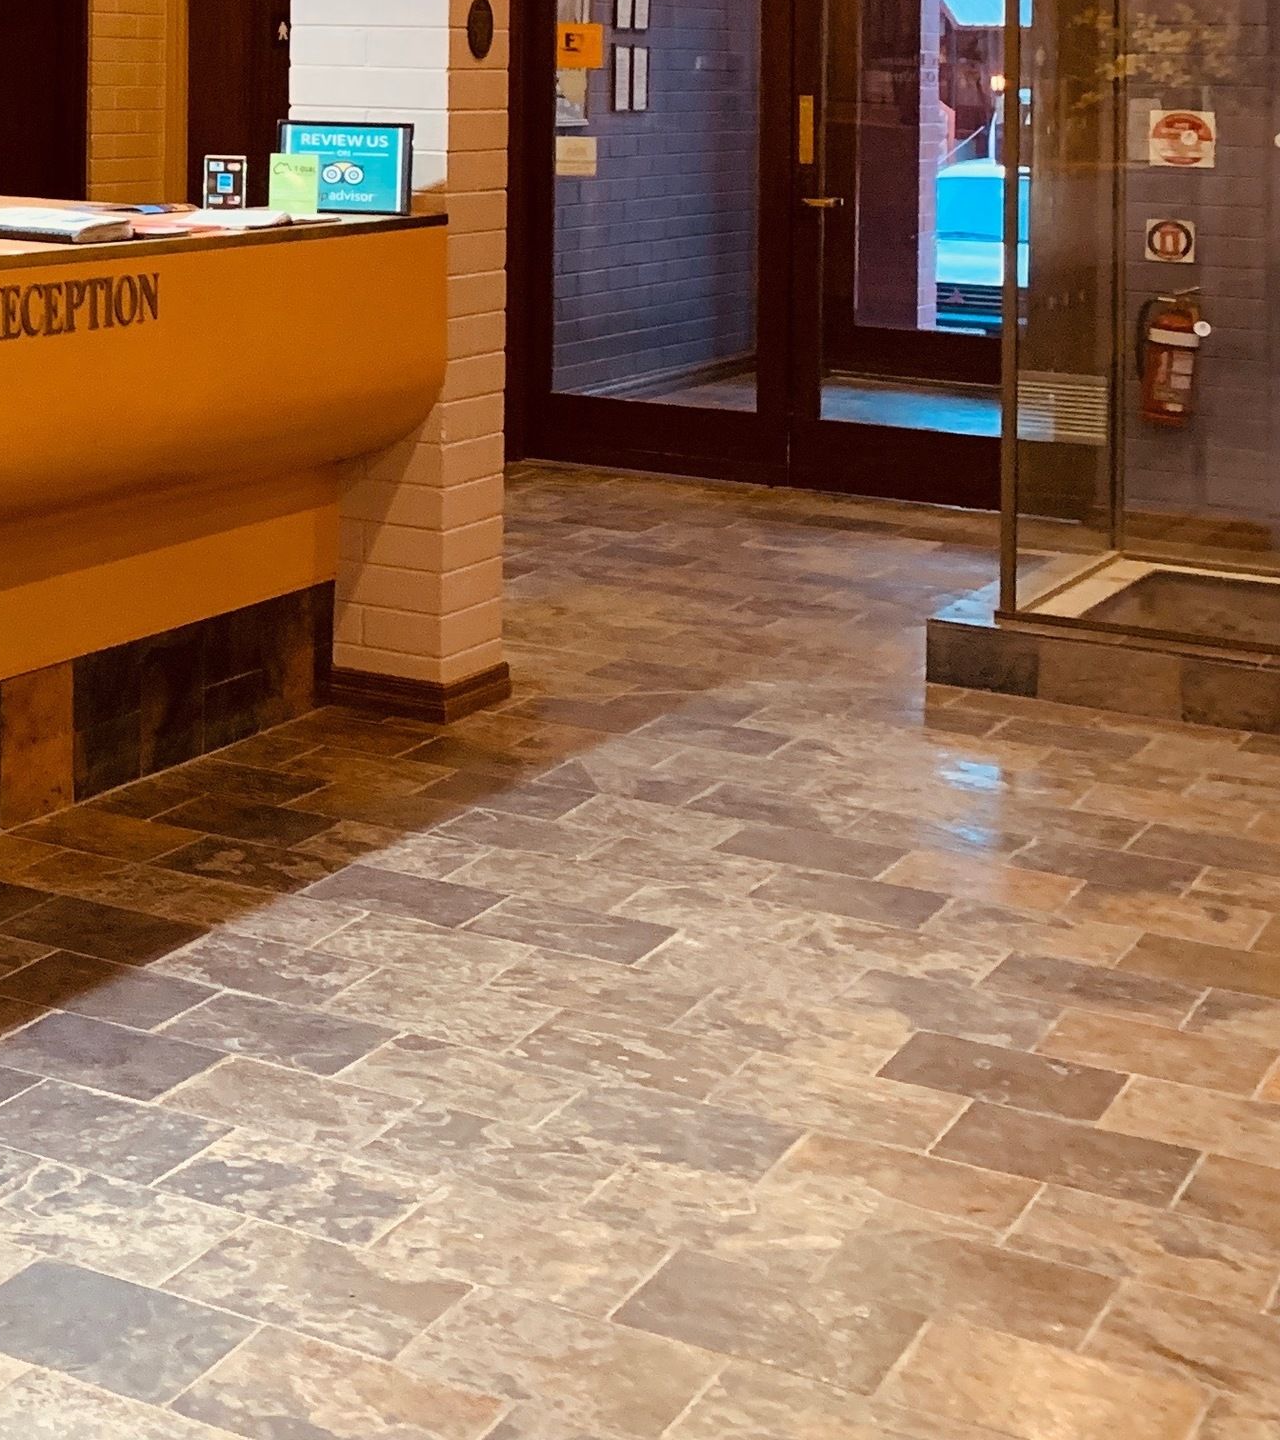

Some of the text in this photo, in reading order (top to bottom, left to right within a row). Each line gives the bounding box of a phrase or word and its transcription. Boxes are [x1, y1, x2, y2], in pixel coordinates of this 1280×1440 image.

[301, 133, 389, 148] REVIEW US
[336, 149, 351, 158] ON
